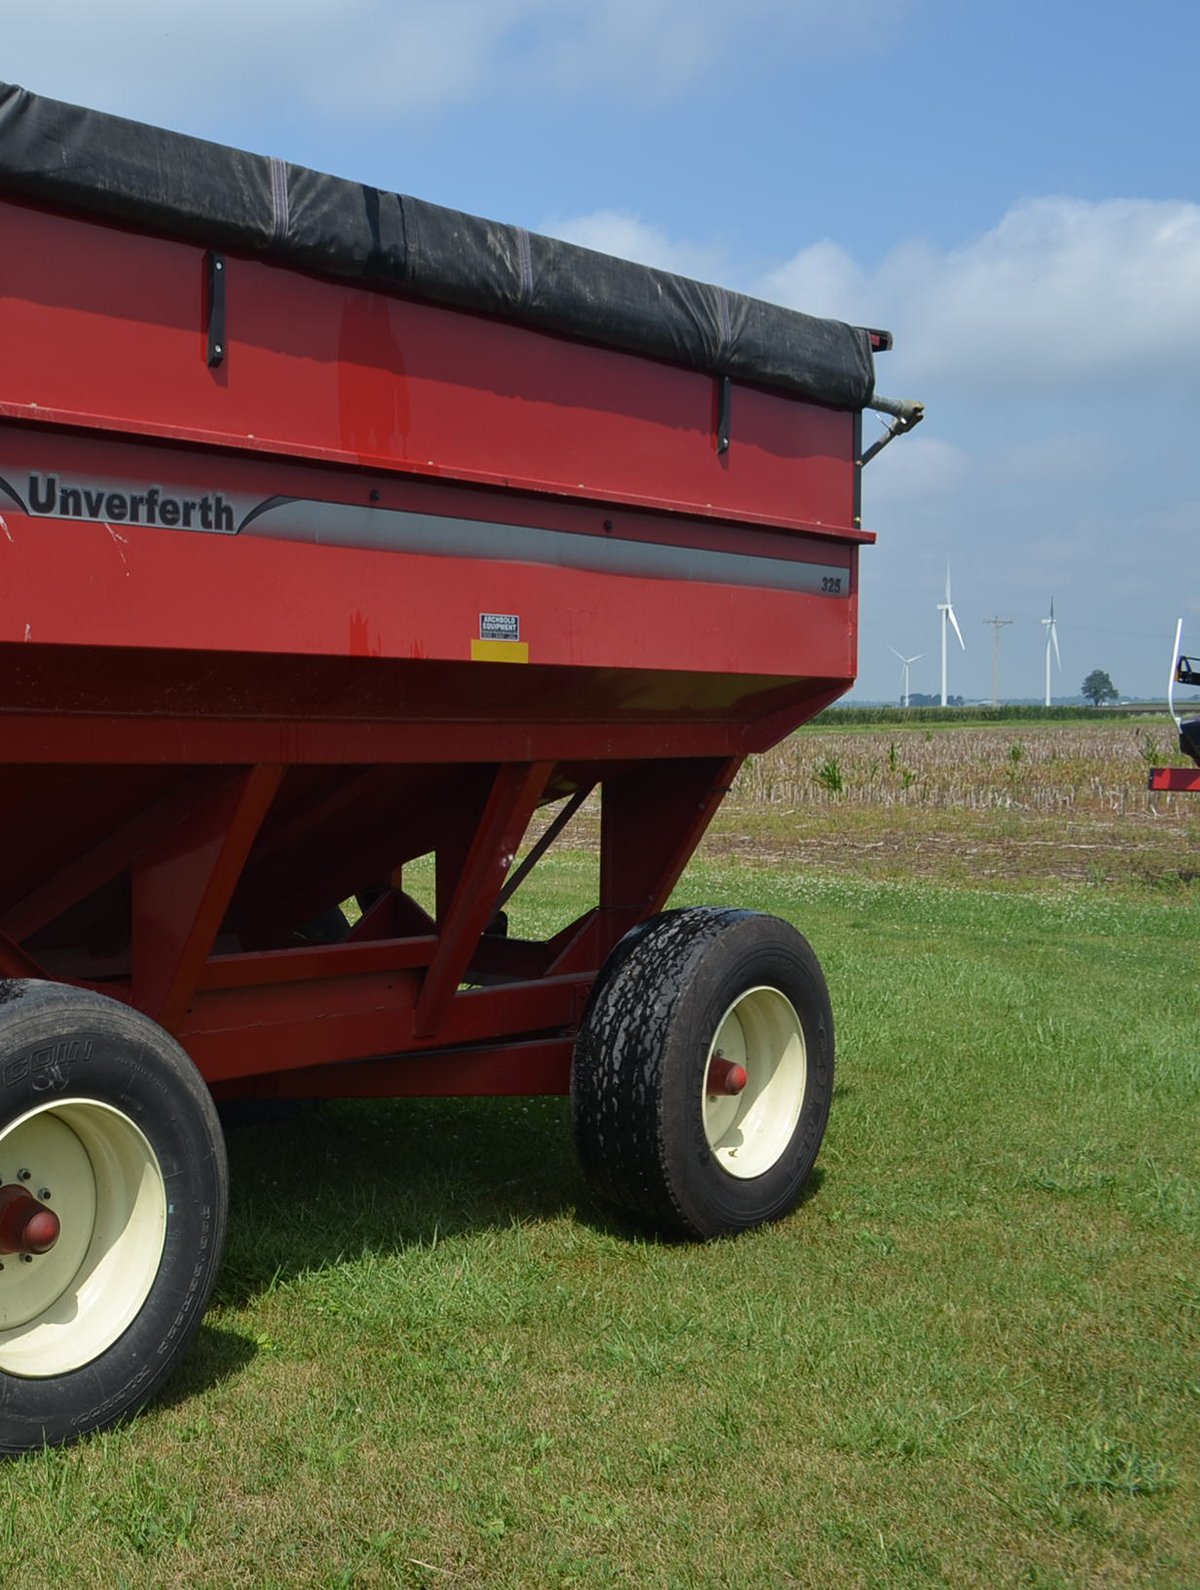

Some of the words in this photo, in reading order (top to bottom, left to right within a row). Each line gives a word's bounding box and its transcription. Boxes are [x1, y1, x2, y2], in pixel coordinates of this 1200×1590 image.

[28, 475, 235, 532] Unverferth
[821, 576, 842, 593] 325
[482, 622, 517, 631] EQUIPMENT
[483, 616, 517, 624] ARCHBOLD
[2, 1039, 95, 1088] COIN
